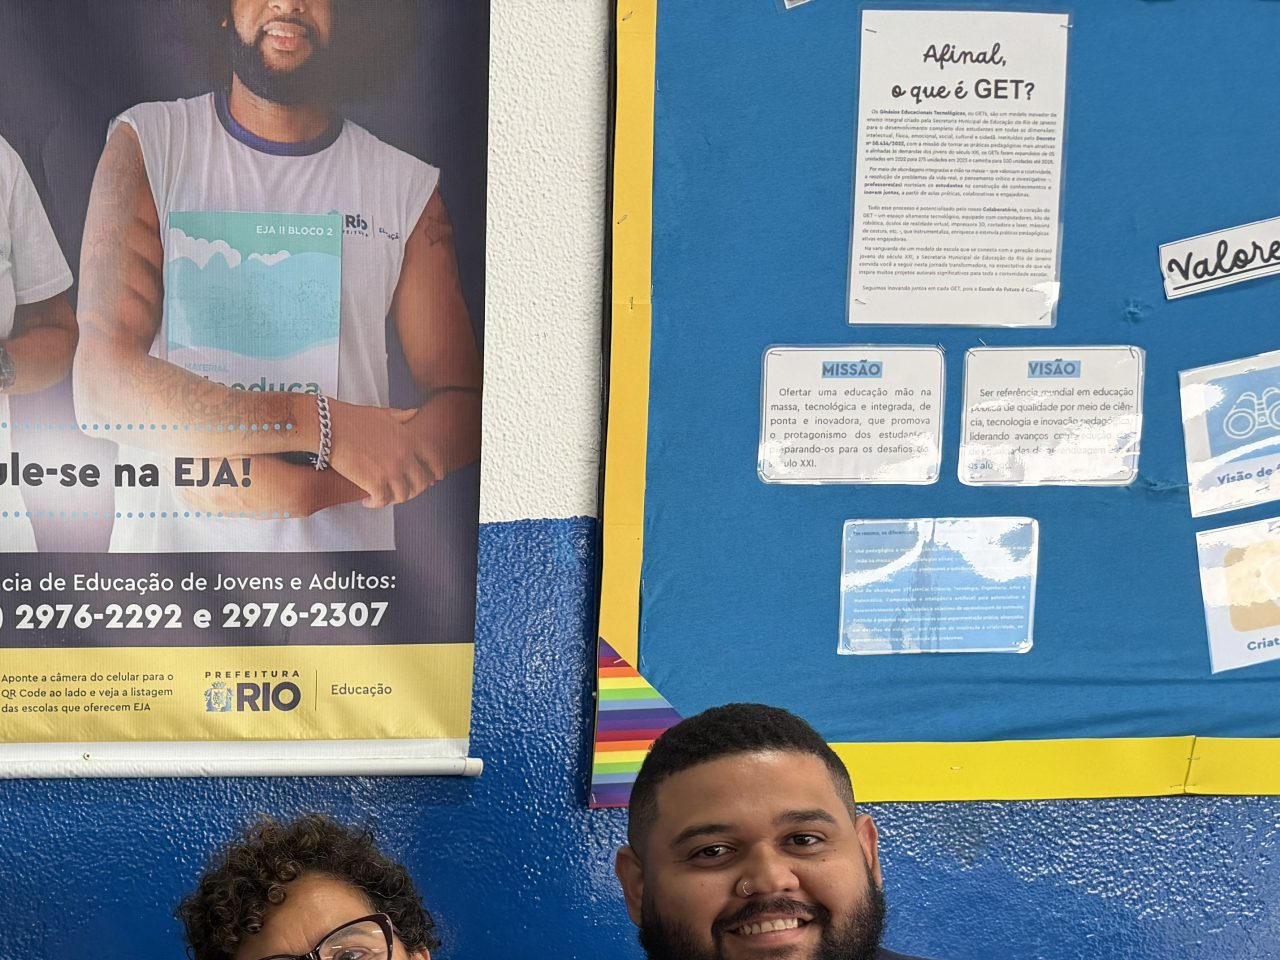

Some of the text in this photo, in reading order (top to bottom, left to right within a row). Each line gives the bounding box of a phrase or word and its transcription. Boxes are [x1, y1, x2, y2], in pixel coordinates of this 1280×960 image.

[923, 43, 1007, 70] Afinal,
[892, 79, 1035, 104] o que é GET?
[256, 225, 276, 234] EJA
[288, 226, 324, 236] BLOCO
[327, 227, 334, 236] 2
[1167, 239, 1280, 281] Valore
[822, 359, 881, 377] MISSÃO
[1028, 358, 1076, 376] VISÃO
[779, 388, 812, 397] Ofertar
[844, 387, 888, 398] educação
[894, 388, 914, 396] mão
[980, 388, 993, 397] Ser
[996, 388, 1039, 398] referência
[1093, 387, 1134, 398] educação
[771, 401, 931, 413] massa, tecnológica e integrada, de
[1017, 403, 1059, 413] qualidade
[1060, 404, 1074, 413] por
[1077, 403, 1098, 411] meio
[1100, 402, 1111, 411] de
[770, 417, 797, 427] ponta
[815, 416, 862, 427] inovadora,
[869, 417, 885, 427] que
[891, 417, 931, 427] promova
[970, 418, 985, 428] cia,
[987, 417, 1032, 428] tecnologia
[784, 430, 871, 441] protagonismo dos
[970, 432, 1010, 441] liderando
[1014, 433, 1049, 443] avanços
[839, 446, 858, 455] para
[877, 444, 913, 453] desafios
[800, 459, 817, 468] XXI.
[114, 460, 160, 487] na
[174, 457, 252, 488] EJA!
[1217, 467, 1273, 485] Visão de
[39, 572, 66, 592] de
[74, 572, 174, 595] Educação
[181, 572, 208, 591] de
[214, 574, 284, 591] Jovens
[290, 578, 302, 590] e
[308, 571, 397, 590] Adultos:
[15, 603, 183, 629] 2976-2292
[193, 608, 212, 629] e
[222, 601, 389, 628] 2976-2307
[1247, 637, 1280, 651] Criat
[1, 674, 38, 684] Aponte
[50, 673, 87, 682] câmera
[90, 672, 104, 682] do
[106, 672, 139, 681] celular
[142, 673, 165, 683] para
[205, 670, 300, 679] PREFEITURA
[1, 689, 17, 700] QR
[19, 688, 47, 698] Code
[65, 688, 87, 697] lado
[98, 688, 119, 698] veja
[131, 687, 173, 698] listagem
[331, 683, 392, 697] Educação
[236, 681, 302, 712] RIO
[1, 703, 151, 714] das escolas que oferecem EJA
